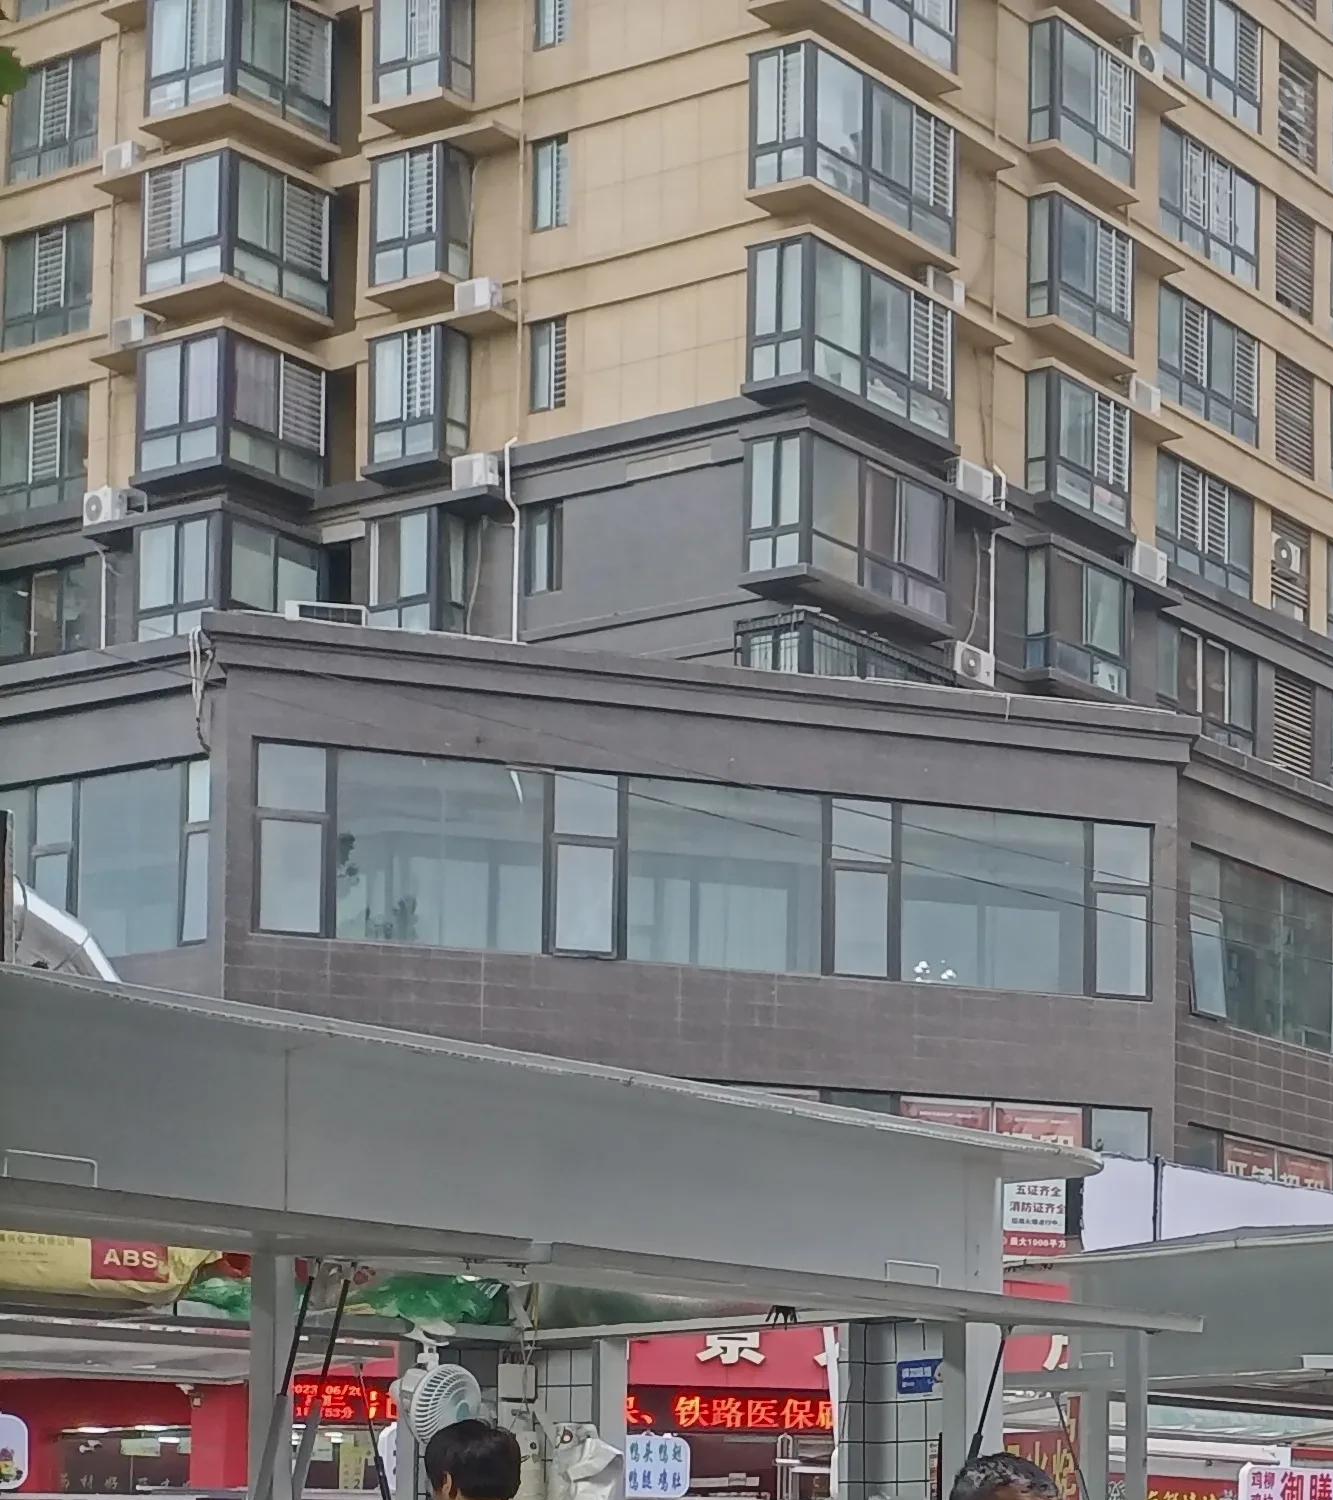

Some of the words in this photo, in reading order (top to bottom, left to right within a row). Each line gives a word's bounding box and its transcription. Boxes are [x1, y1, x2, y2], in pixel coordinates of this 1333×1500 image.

[1015, 1184, 1062, 1197] 五证齐全
[104, 1248, 159, 1269] ABS
[293, 1384, 319, 1394] 023
